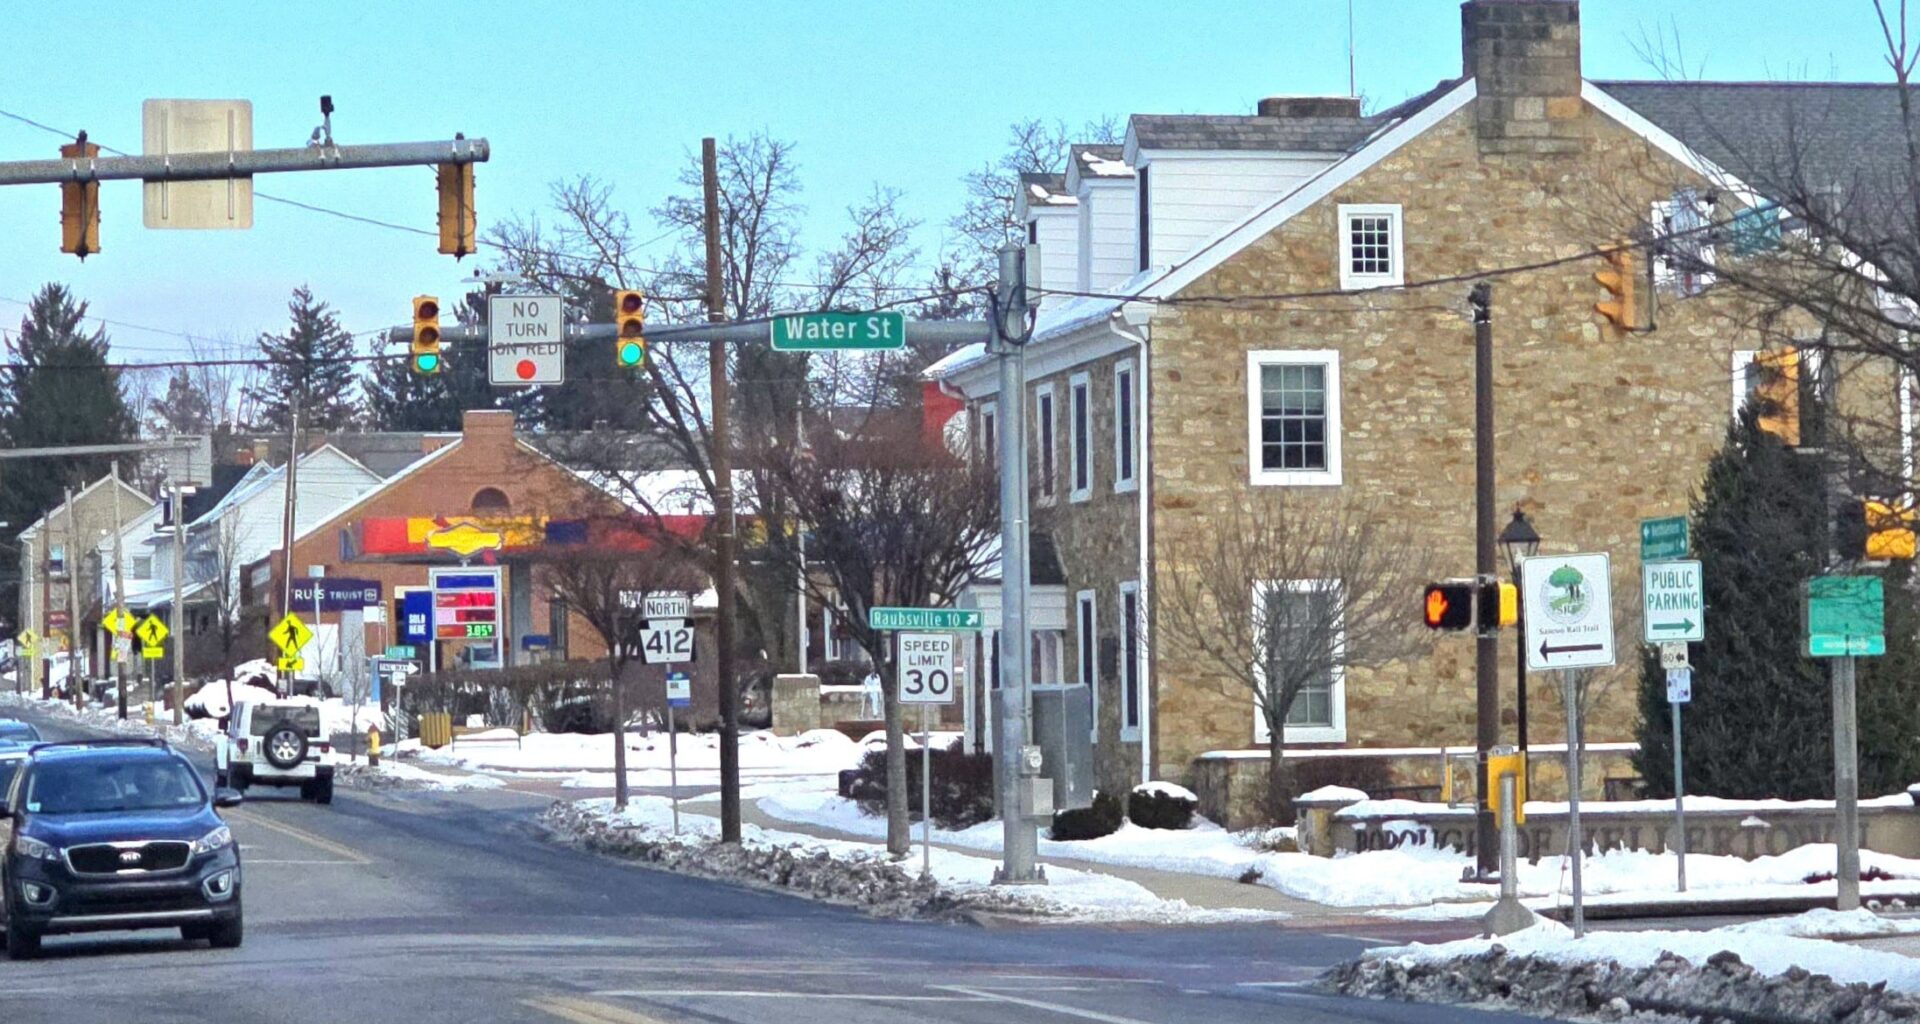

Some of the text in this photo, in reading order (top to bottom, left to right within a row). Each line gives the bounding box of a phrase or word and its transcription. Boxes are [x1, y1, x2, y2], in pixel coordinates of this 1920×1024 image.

[513, 302, 540, 318] NO
[506, 323, 548, 337] TURN
[785, 317, 891, 340] Water St
[496, 341, 558, 356] ON RED
[1651, 571, 1694, 590] PUBLIC
[330, 590, 363, 601] TRUIST
[1648, 593, 1699, 611] PARKING
[647, 601, 686, 616] NORTH
[873, 612, 960, 629] Raubsville 10
[1583, 624, 1600, 633] Trail
[646, 629, 691, 654] 412
[904, 640, 950, 652] SPEED
[909, 655, 944, 666] LIMIT
[905, 669, 949, 695] 30
